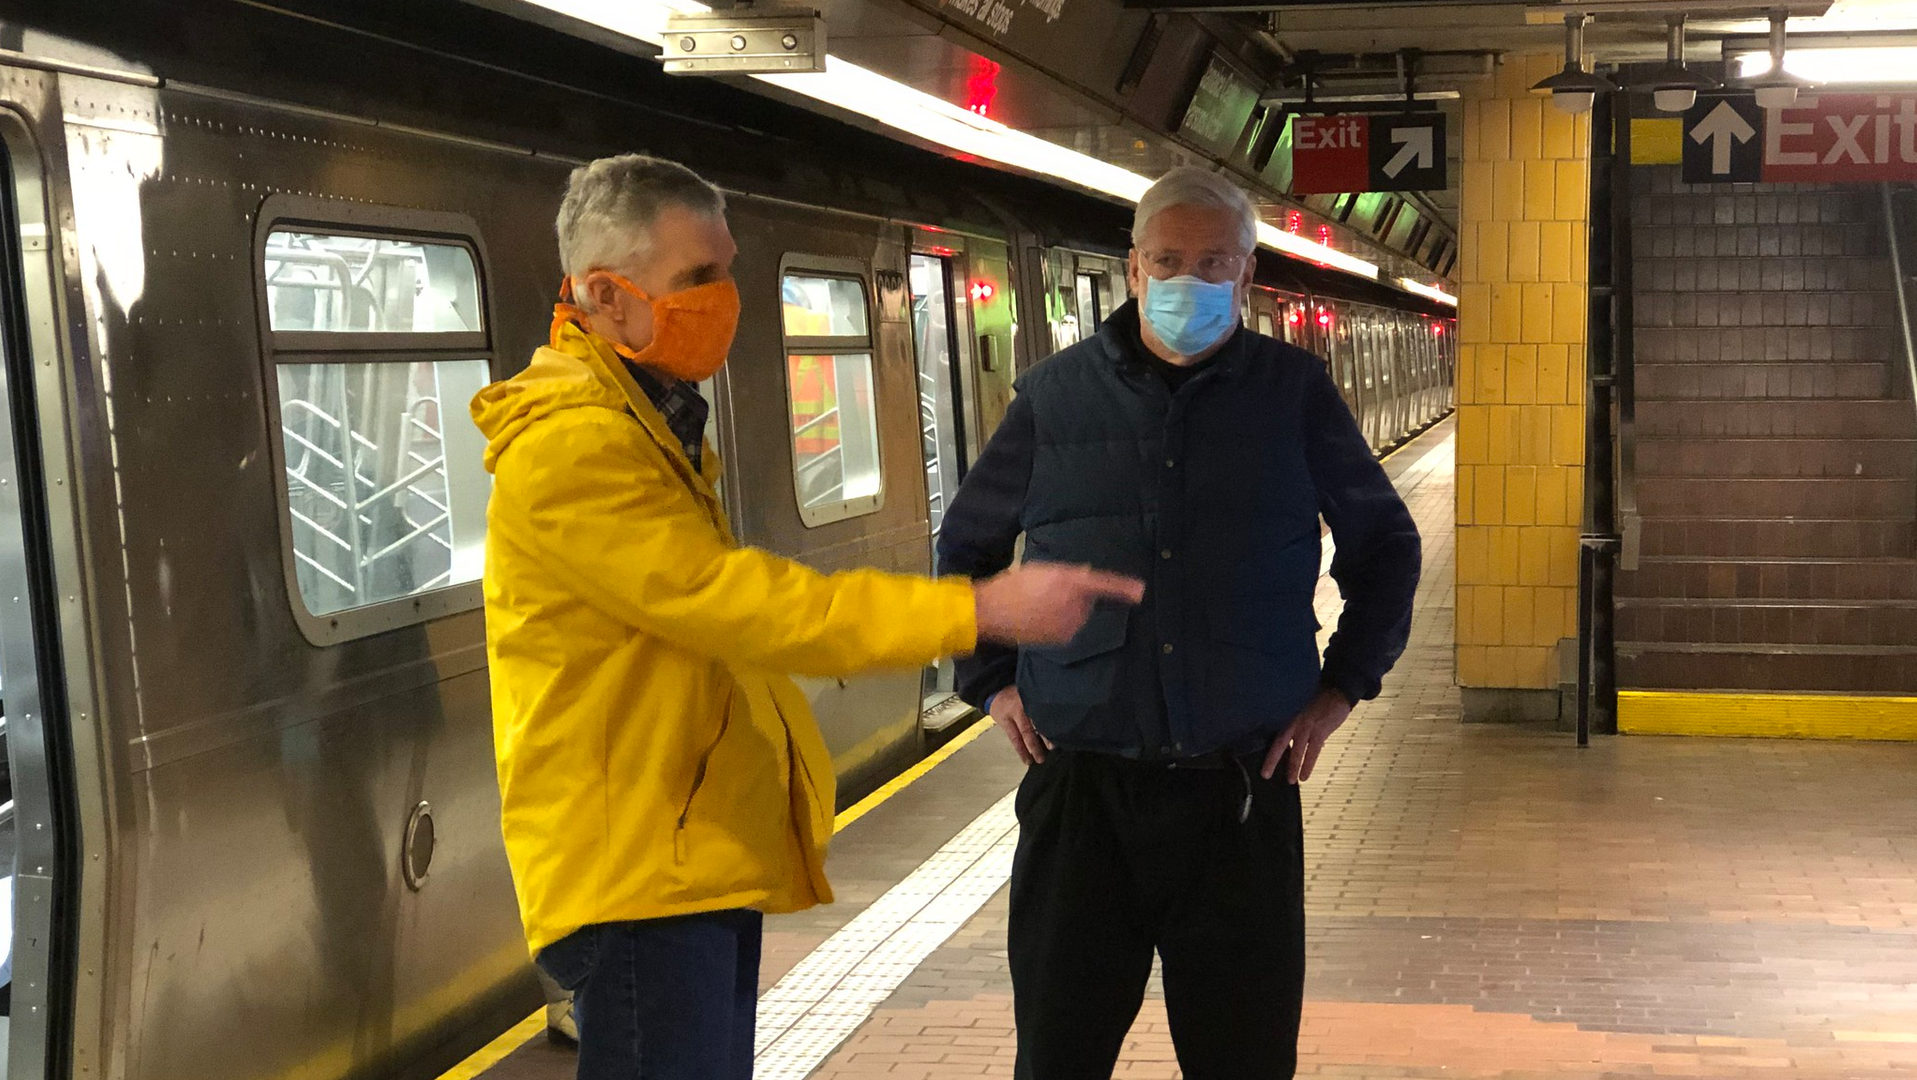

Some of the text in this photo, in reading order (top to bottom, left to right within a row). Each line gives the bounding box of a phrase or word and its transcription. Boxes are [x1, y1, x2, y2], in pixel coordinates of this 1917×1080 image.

[986, 0, 1014, 36] stops
[1294, 120, 1361, 149] Exit
[1766, 95, 1917, 165] Exit
